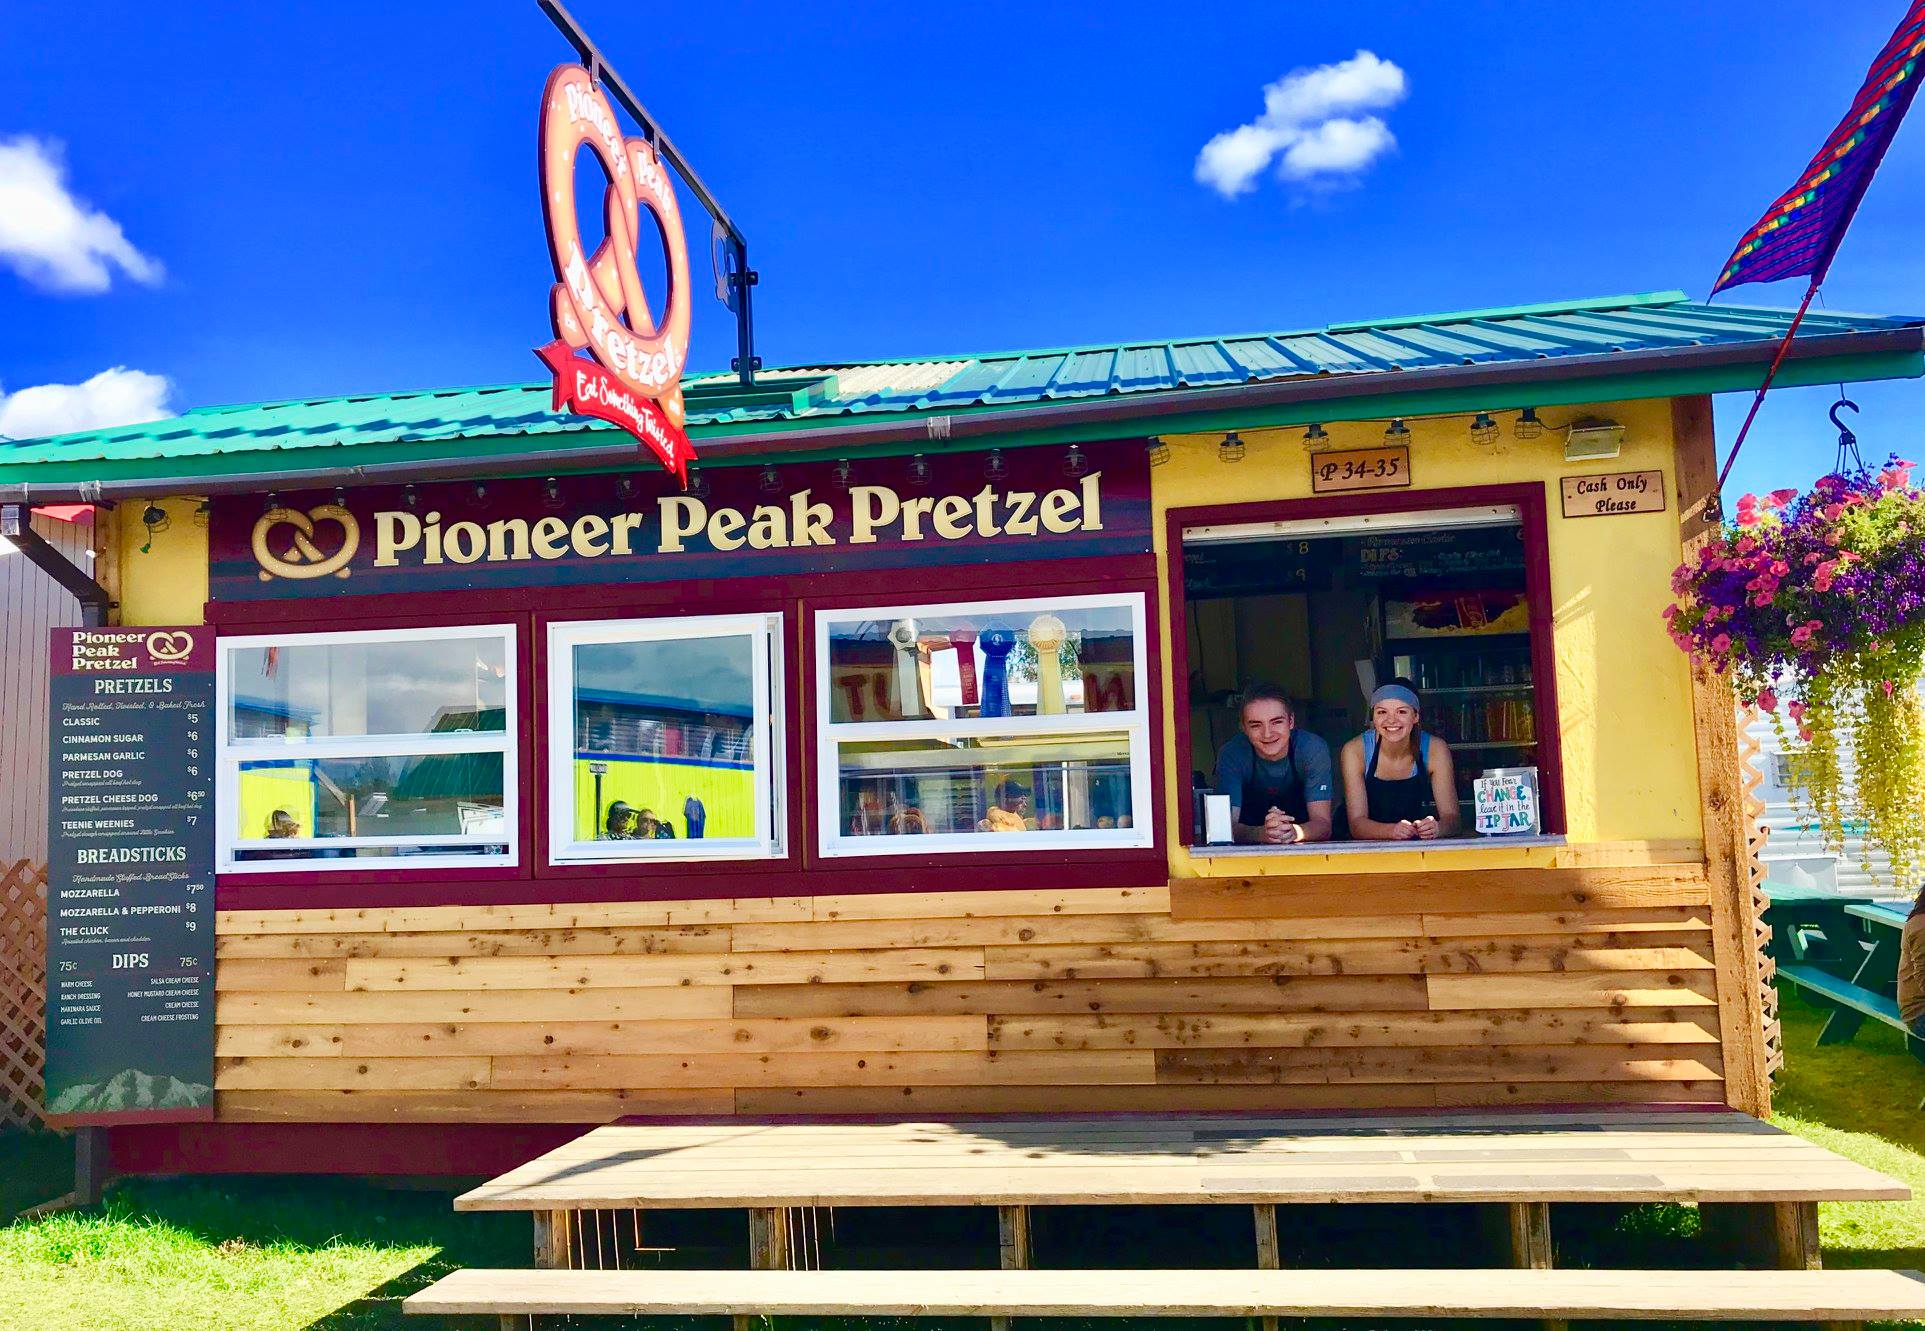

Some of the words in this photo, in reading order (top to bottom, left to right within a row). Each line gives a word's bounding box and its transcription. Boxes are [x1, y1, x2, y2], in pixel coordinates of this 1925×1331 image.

[564, 241, 679, 386] Pretzel
[576, 370, 598, 401] Eat
[599, 377, 645, 434] Something
[1320, 462, 1338, 482] P
[1341, 456, 1401, 480] 34-35
[1576, 477, 1608, 496] Cash
[1616, 475, 1648, 494] Only
[1595, 498, 1638, 513] Please
[373, 510, 644, 567] Pioneer
[656, 488, 837, 553] Peak
[848, 471, 1104, 545] Pretzel
[72, 631, 146, 644] Pioneer
[72, 645, 120, 657] Peak
[72, 657, 138, 670] Pretzel
[94, 678, 172, 694] PRETZELS
[62, 702, 86, 711] Hand
[156, 701, 182, 710] Baked
[183, 700, 206, 710] Fresh
[62, 718, 100, 727] CLASSIC
[187, 713, 199, 724] $5
[62, 735, 111, 744] CINNAMON
[113, 734, 144, 743] SUGAR
[187, 731, 198, 741] $6
[62, 752, 111, 762] PARMESAN
[112, 751, 146, 761] GARLIC
[187, 748, 198, 759] $6
[62, 770, 101, 779] PRETZEL
[103, 770, 123, 778] DOG
[187, 766, 198, 776] $6
[1481, 780, 1487, 790] If
[1489, 780, 1500, 790] you
[1502, 778, 1517, 786] Fear
[62, 795, 101, 804] PRETZEL
[102, 795, 137, 803] CHEESE
[138, 794, 159, 802] DOG
[1480, 803, 1497, 813] leave
[1518, 800, 1531, 811] the
[61, 821, 93, 830] TEENIE
[94, 820, 135, 828] WEENIES
[186, 816, 197, 826] $7
[1477, 813, 1501, 829] TIP
[1501, 811, 1532, 831] JAR
[77, 846, 187, 864] BREADSTICKS
[72, 874, 115, 883] Handmade
[115, 873, 142, 883] Stuffed
[60, 888, 120, 899] MOZZARELLA
[60, 908, 119, 917] MOZZARELLA
[121, 907, 129, 915] &
[130, 905, 181, 915] PEPPERONI
[185, 902, 197, 913] $8
[60, 928, 78, 936] THE
[79, 926, 109, 935] CLUCK
[185, 922, 197, 932] $9
[112, 954, 149, 969] DIPS
[77, 992, 101, 1000] DRESSING
[182, 988, 199, 996] CHEESE
[86, 1004, 101, 1012] SAUCE
[175, 1013, 199, 1021] FROSTING
